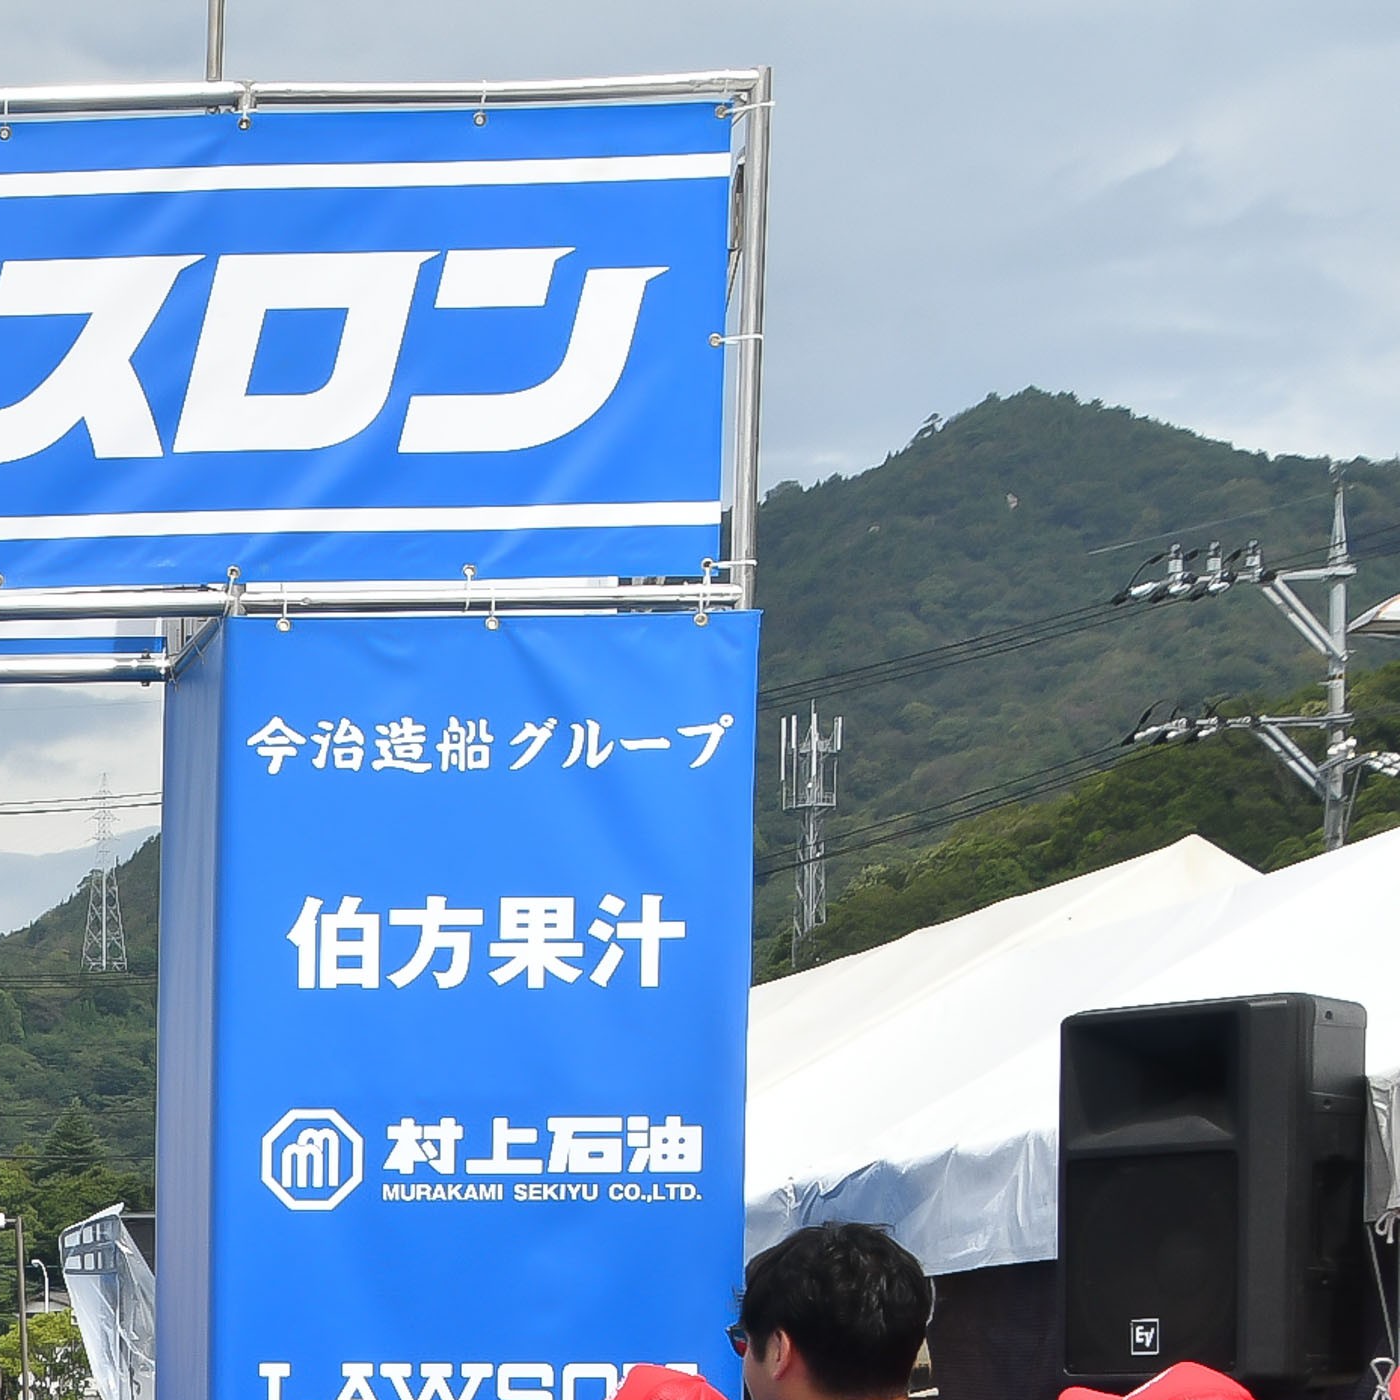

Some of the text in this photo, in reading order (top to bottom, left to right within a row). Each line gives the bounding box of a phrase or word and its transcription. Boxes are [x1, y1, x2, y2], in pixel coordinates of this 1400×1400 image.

[246, 714, 734, 775] 今治造船グループ
[286, 893, 686, 989] 伯方果汁
[383, 1116, 702, 1174] 村上石油
[382, 1183, 503, 1202] MURAKAMI
[514, 1183, 598, 1202] SEKIYU
